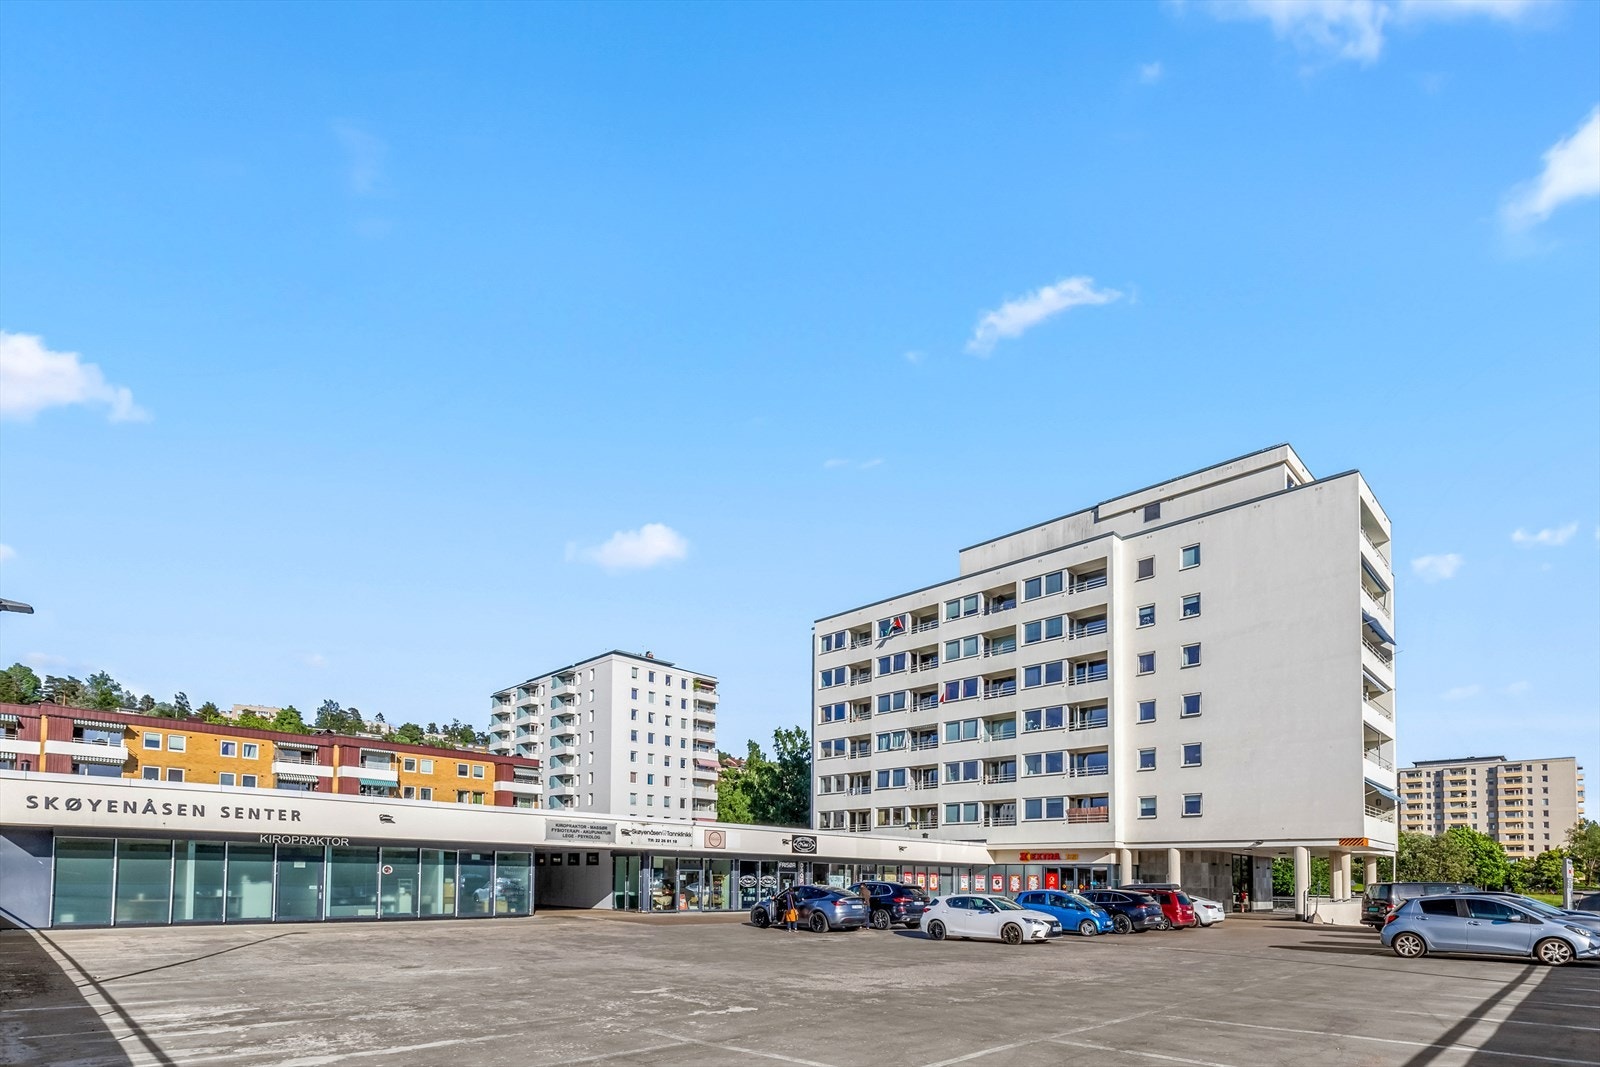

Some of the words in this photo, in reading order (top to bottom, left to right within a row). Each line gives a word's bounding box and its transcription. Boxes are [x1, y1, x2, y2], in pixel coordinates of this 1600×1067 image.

[26, 795, 206, 817] SKØYENÅSEN
[220, 806, 302, 822] SENTER
[260, 834, 349, 847] KIROPRAKTOR
